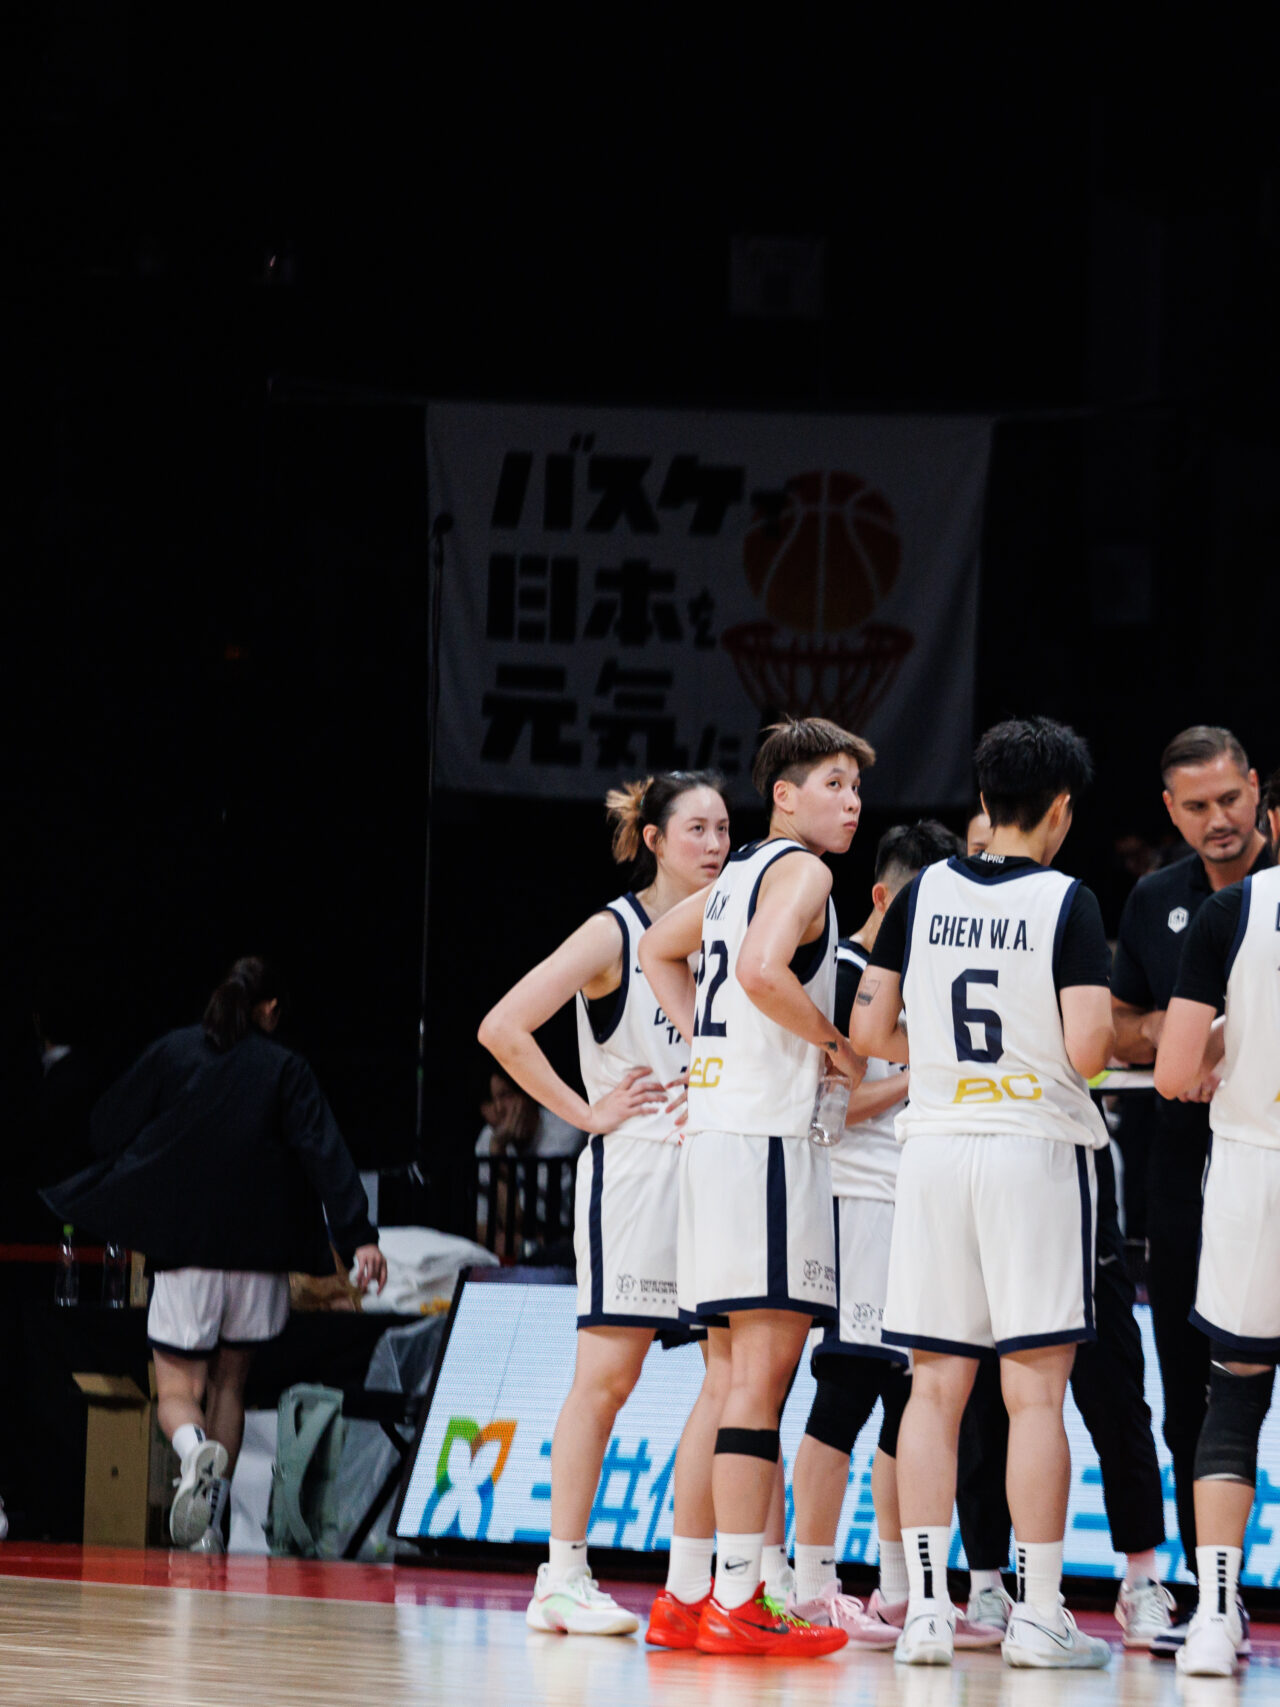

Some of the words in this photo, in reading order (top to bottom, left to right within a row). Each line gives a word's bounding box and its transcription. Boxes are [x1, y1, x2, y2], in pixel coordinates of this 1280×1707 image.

[486, 552, 717, 648] 日本を
[928, 914, 984, 948] CHEN
[990, 918, 1034, 952] W.A.
[951, 968, 1005, 1063] 6
[952, 1073, 1043, 1104] BC
